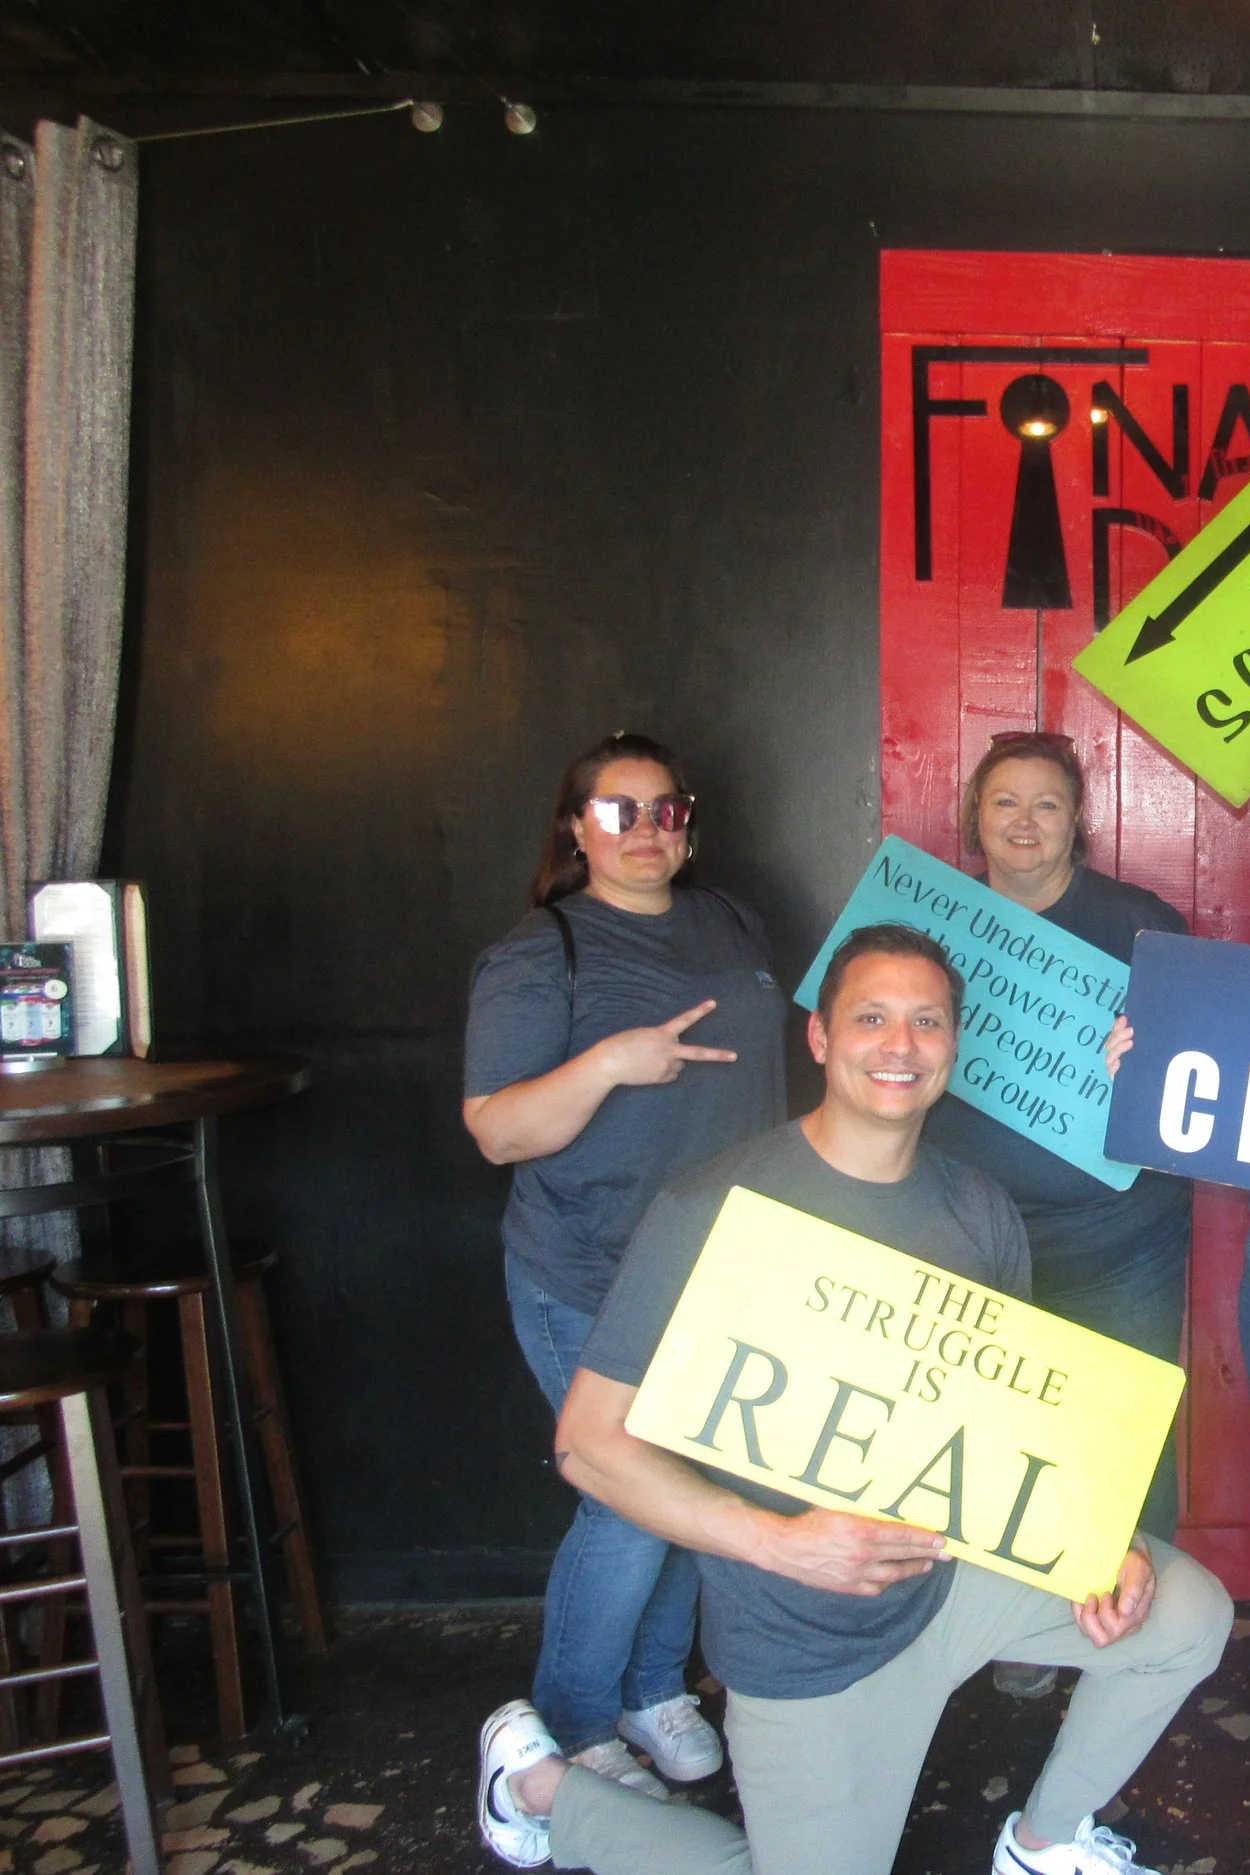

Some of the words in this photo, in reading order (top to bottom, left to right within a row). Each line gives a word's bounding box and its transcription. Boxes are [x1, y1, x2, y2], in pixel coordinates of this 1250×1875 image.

[874, 856, 969, 922] Never
[968, 907, 1128, 1017] Underesti
[967, 957, 1076, 1031] Power
[962, 1056, 1075, 1136] Groups
[975, 1011, 1077, 1088] People
[1077, 1068, 1110, 1106] in
[804, 1275, 1069, 1406] STRUGGLE
[911, 1269, 1005, 1336] THE
[901, 1360, 948, 1403] IS
[684, 1336, 1065, 1575] REAL
